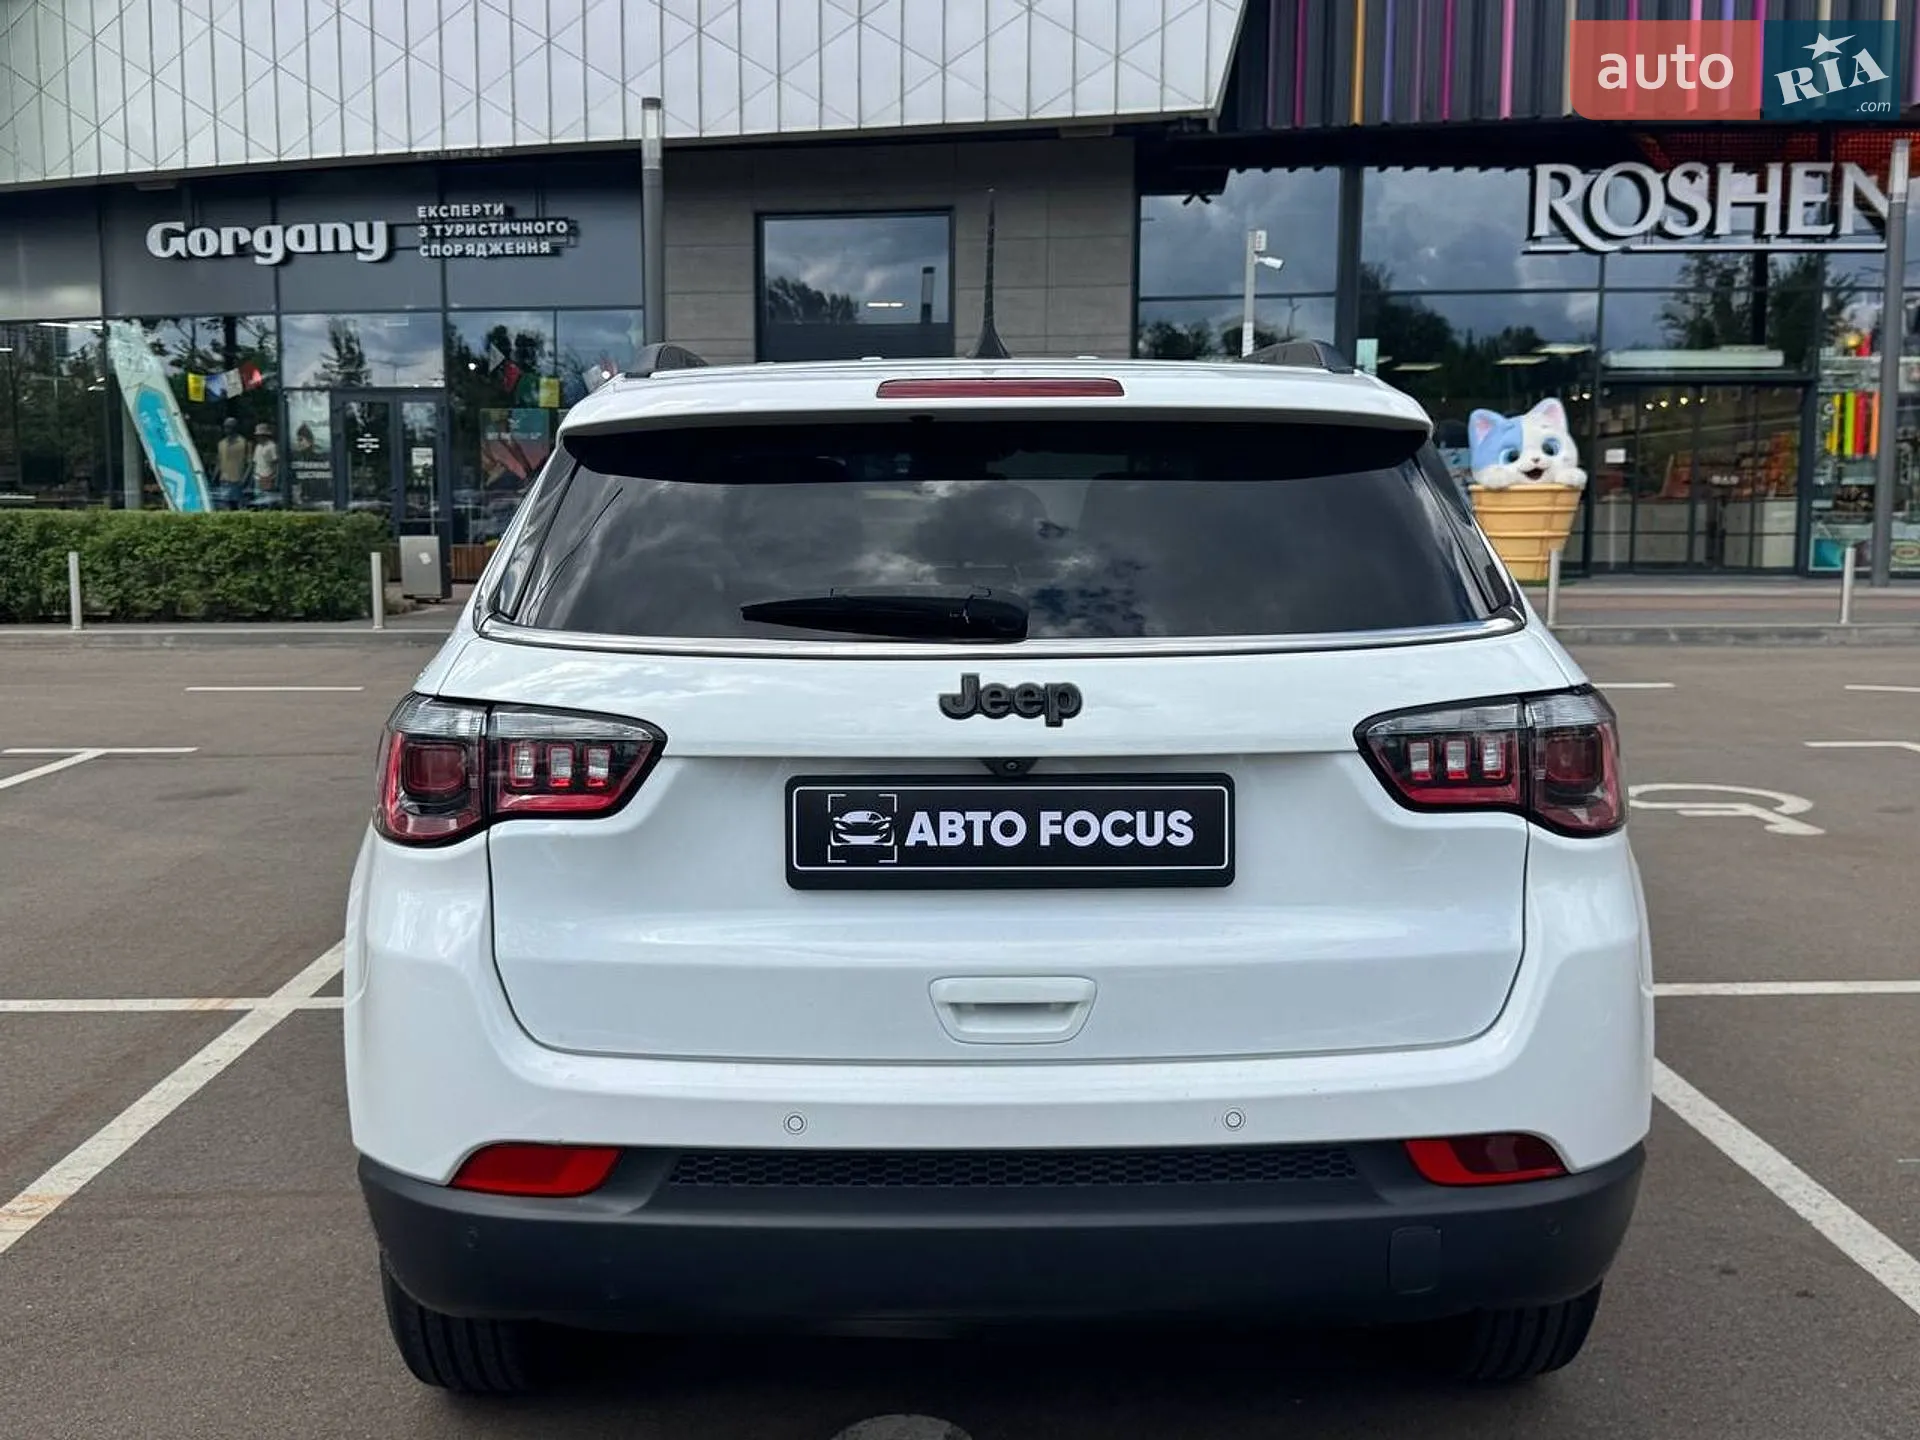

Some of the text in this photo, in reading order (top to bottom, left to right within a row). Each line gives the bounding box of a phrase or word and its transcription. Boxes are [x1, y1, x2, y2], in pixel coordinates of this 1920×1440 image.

[417, 203, 504, 218] ЕКСПЕРТИ
[1533, 161, 1889, 252] ROSHEN
[146, 220, 388, 265] Gorgany
[419, 220, 569, 237] З ТУРИСТИЧНОГО
[419, 241, 551, 257] СПОРЯДЖЕННЯ
[938, 672, 1084, 728] Jeep
[905, 810, 1195, 848] АВТО FOCUS
